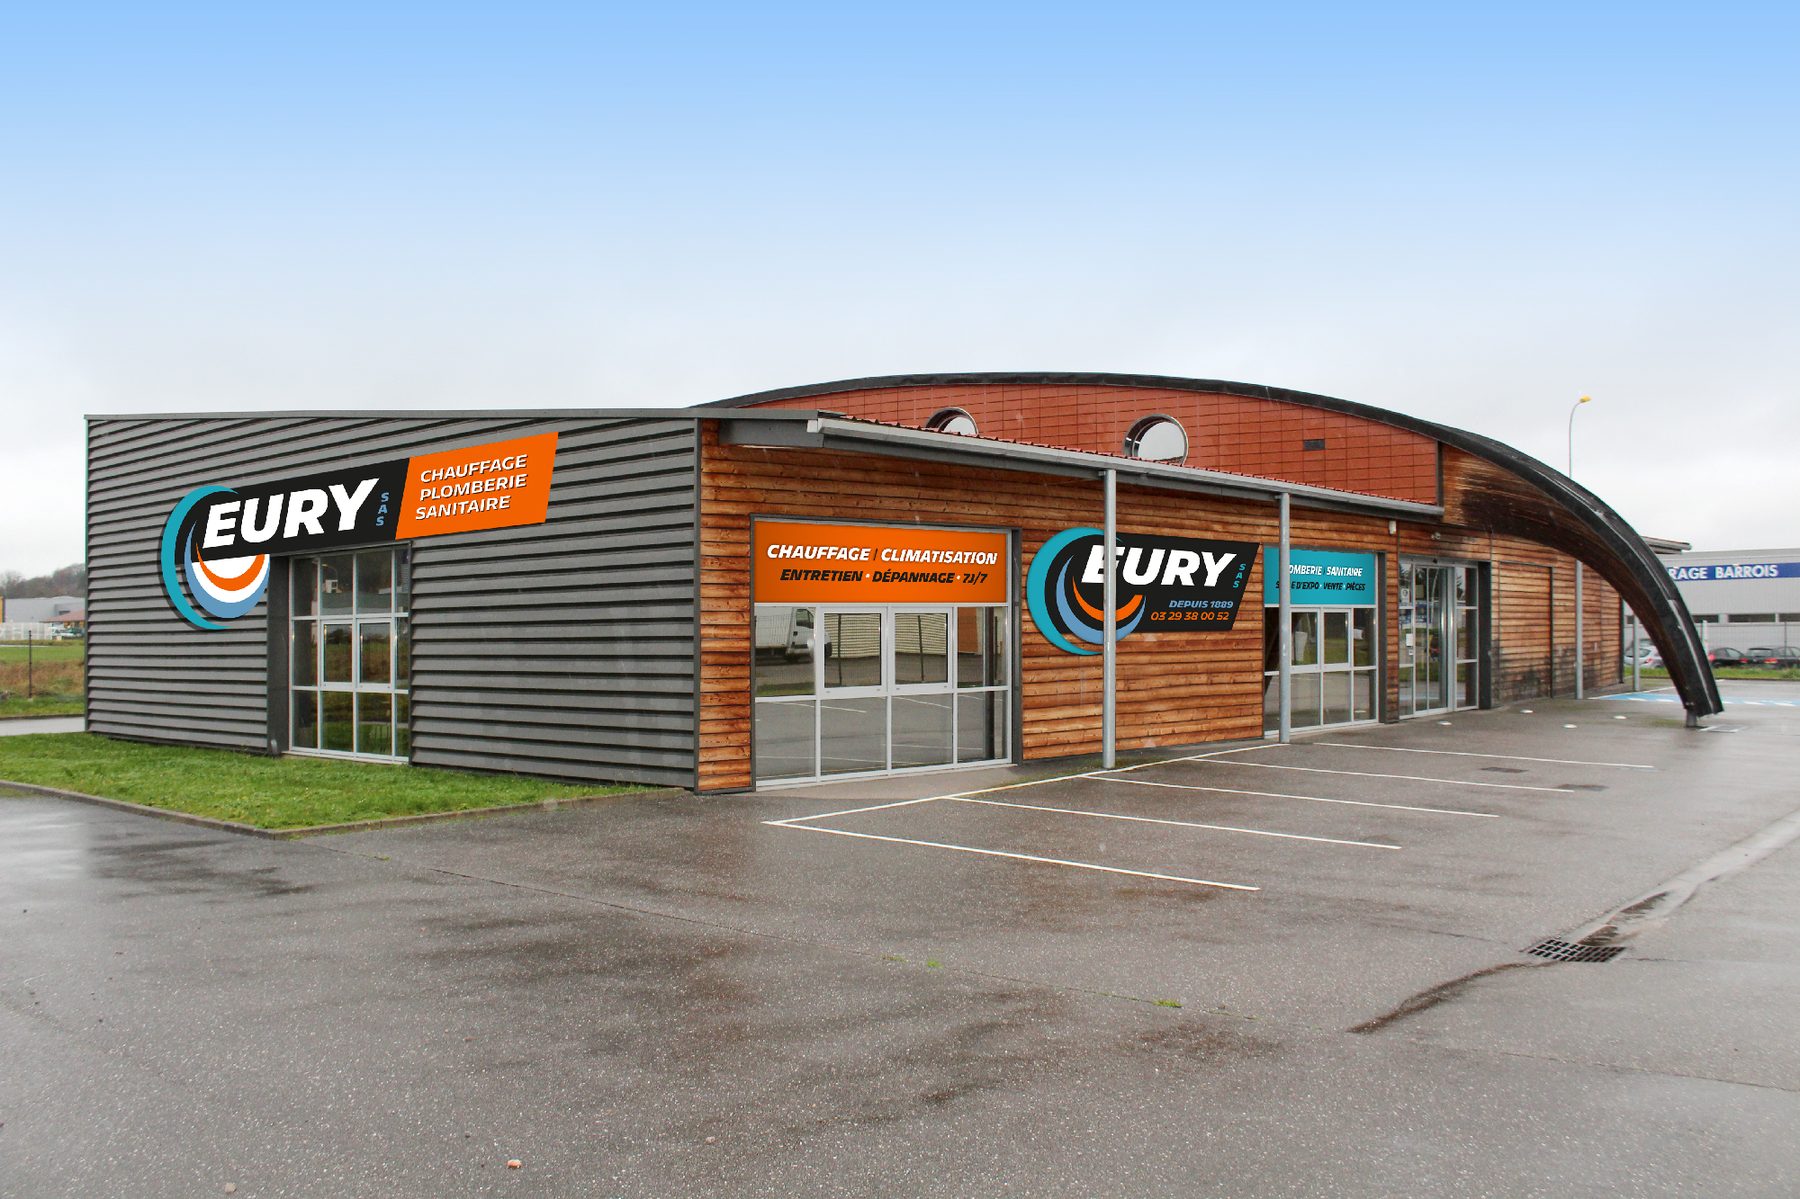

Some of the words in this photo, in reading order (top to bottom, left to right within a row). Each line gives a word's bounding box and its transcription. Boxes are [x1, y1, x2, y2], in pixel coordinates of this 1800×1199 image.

[420, 453, 528, 484] CHAUFFAGE
[419, 473, 528, 502] PLOMBERIE
[202, 478, 379, 549] EURY
[375, 491, 390, 527] SAS
[415, 494, 512, 521] SANITAIRE
[767, 544, 871, 561] CHAUFFAGE
[881, 548, 998, 565] CLIMATISATION
[1081, 544, 1237, 587] EURY
[780, 568, 864, 582] ENTRETIEN
[872, 568, 955, 584] DÉPANNAGE
[1232, 563, 1247, 589] SAS
[1289, 565, 1322, 575] OMBERIE
[1327, 567, 1363, 576] SANITAIRE
[1668, 567, 1708, 579] RAGE
[1715, 565, 1778, 578] BARROIS
[1324, 582, 1342, 590] VENTE
[1168, 600, 1209, 608] DEPUIS
[1210, 600, 1233, 609] 1889
[1150, 612, 1167, 621] 03
[1167, 612, 1183, 621] 29
[1184, 612, 1199, 621] 38
[1200, 612, 1215, 621] 00
[1216, 612, 1230, 621] 52
